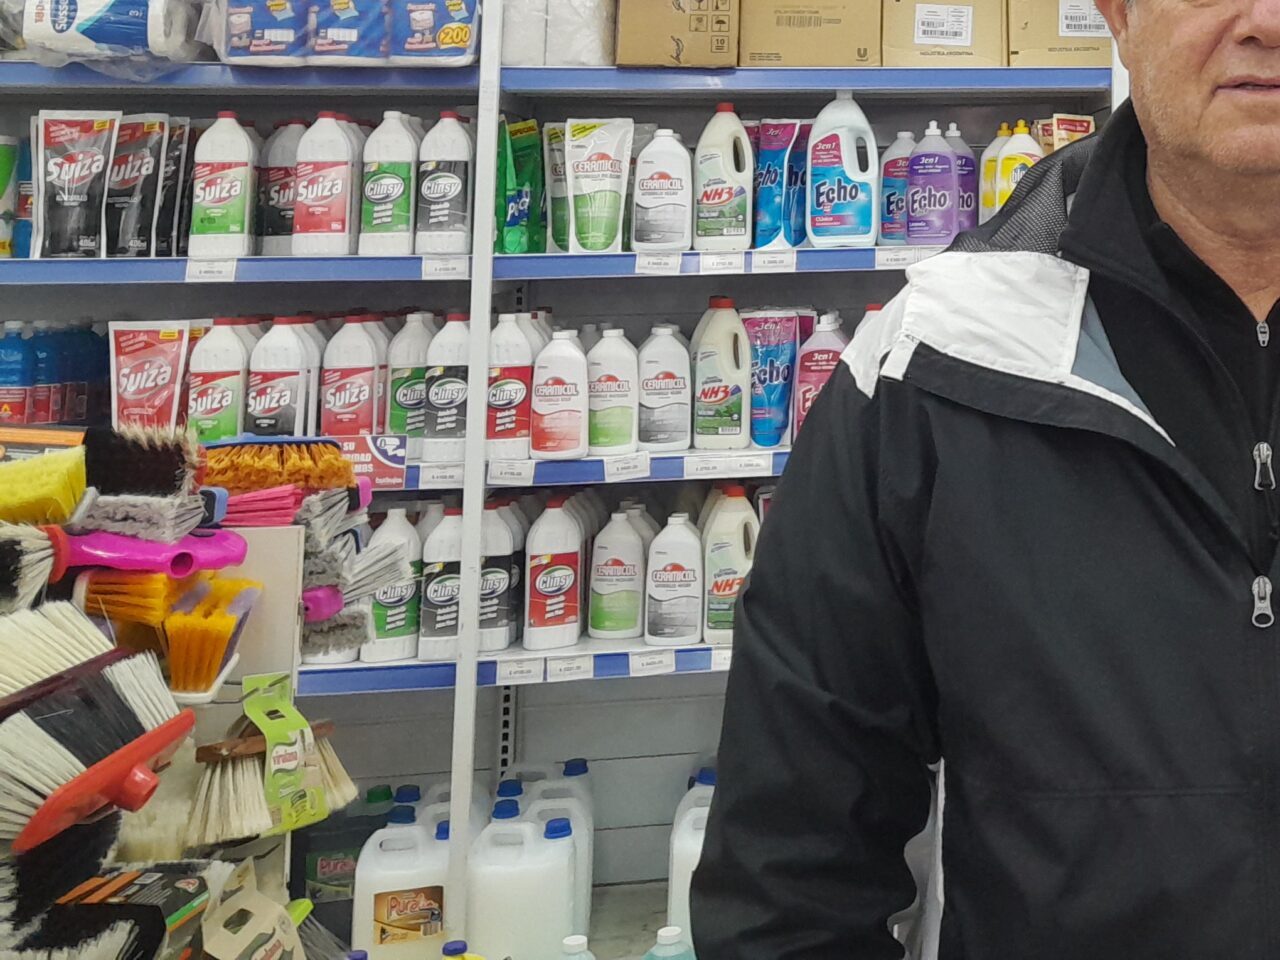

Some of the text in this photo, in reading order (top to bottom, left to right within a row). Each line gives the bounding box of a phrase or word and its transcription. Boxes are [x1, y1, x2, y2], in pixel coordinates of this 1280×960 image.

[46, 152, 105, 183] Suiza
[110, 153, 156, 181] uiza
[572, 159, 623, 173] CERAMICOL
[638, 177, 684, 191] CERAMICOL
[755, 163, 780, 189] cho
[193, 177, 243, 203] Suiza
[268, 182, 296, 206] Sui
[296, 176, 343, 202] Suiza
[367, 181, 404, 196] Clinsy
[423, 180, 462, 196] Clinsy
[699, 186, 735, 205] NH3
[814, 177, 859, 208] Echo
[885, 191, 906, 216] Ec
[909, 186, 948, 215] Echo
[119, 363, 172, 392] Suiza
[588, 380, 632, 392] CERAMICOL
[642, 378, 687, 391] CERAMICOL
[325, 382, 370, 409] Suiza
[431, 385, 465, 401] Clinsy
[489, 386, 524, 402] Clinsy
[534, 383, 579, 396] CERAMICOL
[698, 384, 731, 401] NH3
[189, 387, 233, 414] Suiza
[248, 386, 291, 413] Suiza
[480, 575, 507, 593] linsy
[537, 573, 573, 590] Clinsy
[652, 569, 698, 583] CERAMICOL
